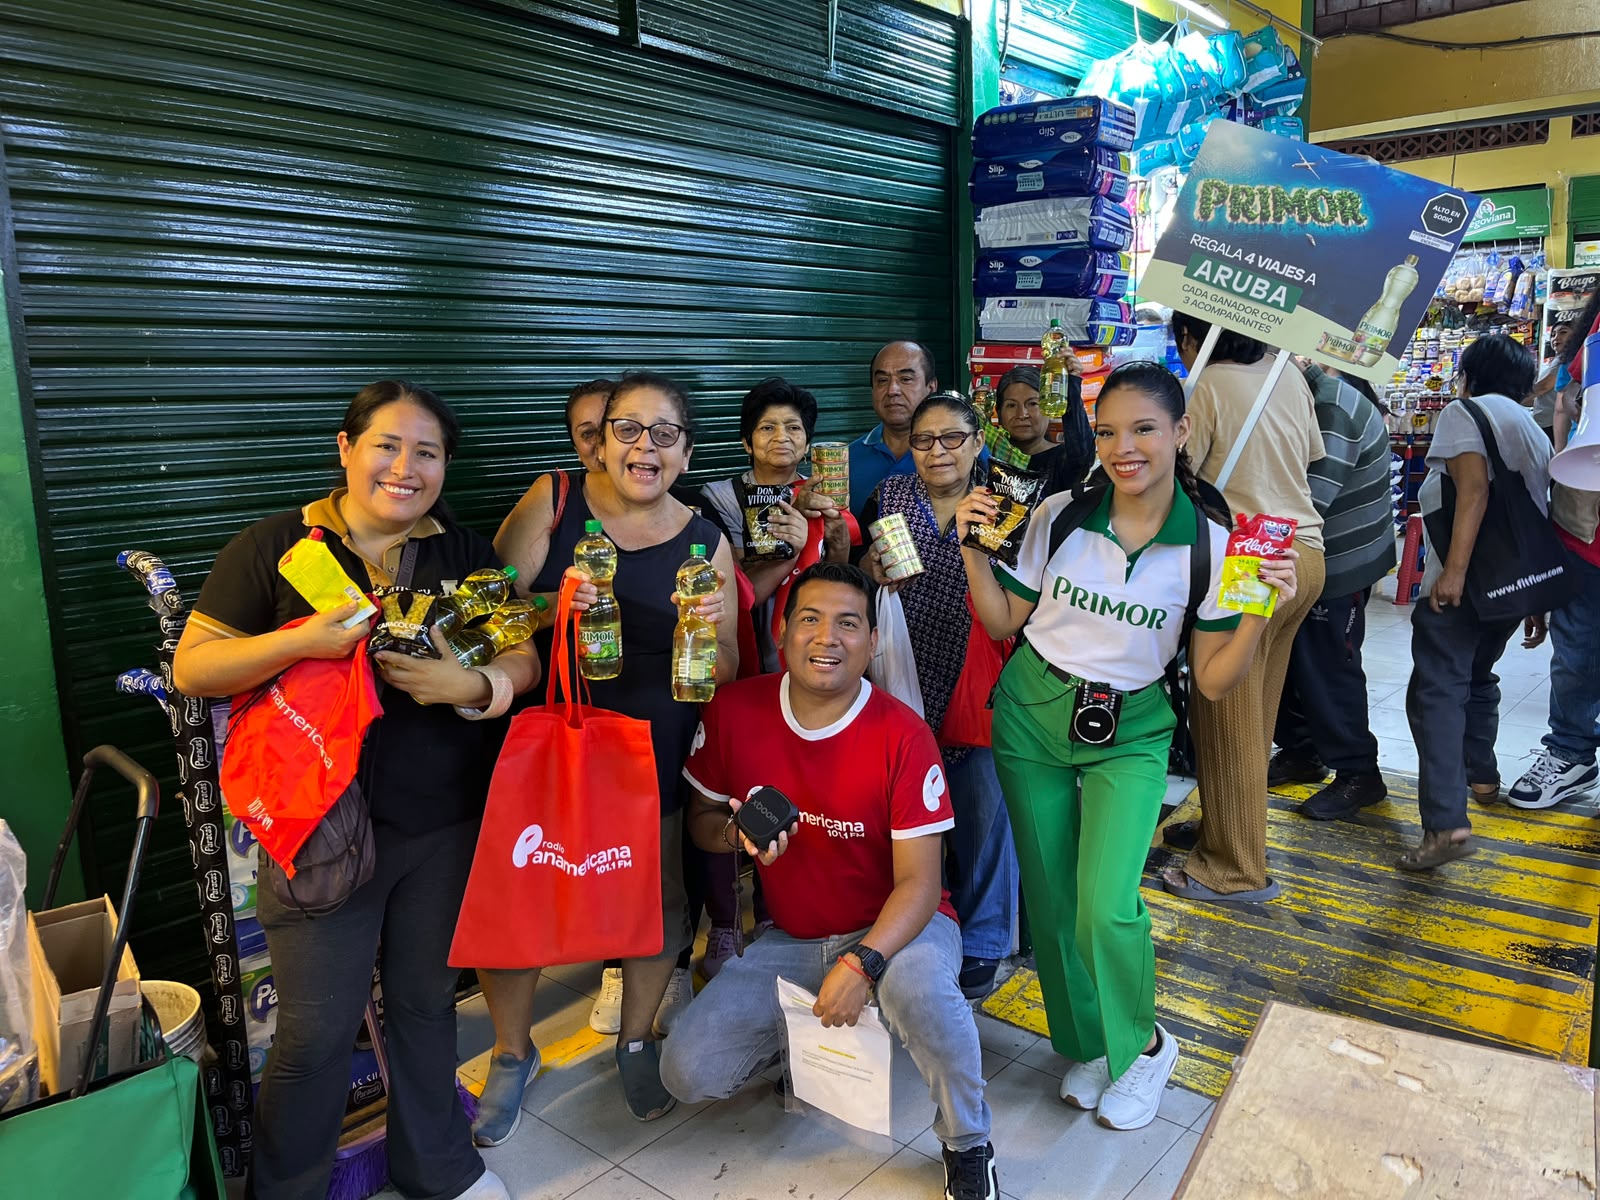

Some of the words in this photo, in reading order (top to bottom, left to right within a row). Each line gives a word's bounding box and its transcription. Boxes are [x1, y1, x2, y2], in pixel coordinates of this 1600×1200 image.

[1194, 178, 1368, 226] PRIMOR
[1432, 204, 1450, 215] ALTO
[1450, 210, 1461, 219] EN
[1433, 213, 1453, 224] SODIO
[1469, 211, 1512, 230] egoviana
[1190, 233, 1243, 261] REGALA
[1244, 252, 1255, 265] 4
[1257, 255, 1305, 281] VIAJES
[1304, 273, 1317, 286] A
[1193, 259, 1288, 308] ARUBA
[1557, 275, 1596, 290] Bingo
[1181, 284, 1209, 300] CADA
[1209, 291, 1260, 318] GANADOR
[1260, 310, 1284, 326] CON
[1182, 296, 1190, 304] 3
[1189, 297, 1273, 335] ACOMPAÑANTES
[1555, 310, 1583, 322] Bin
[1359, 321, 1393, 340] PRIMOR
[1326, 336, 1357, 353] PRIMOR
[747, 494, 783, 506] VITTORIO
[756, 486, 774, 495] DON
[1238, 559, 1260, 567] MAYO
[1052, 575, 1168, 631] PRIMOR
[163, 618, 186, 628] Parac
[579, 630, 615, 643] RIMOR
[194, 738, 206, 767] Paracas
[199, 782, 210, 811] Paracas
[750, 798, 780, 825] xboom
[799, 809, 866, 833] mericana
[204, 825, 215, 853] Paracas
[541, 840, 565, 854] radio
[595, 860, 617, 875] 101.1
[617, 859, 633, 869] FM
[209, 871, 220, 900] Paracas
[213, 914, 224, 942] Paracas
